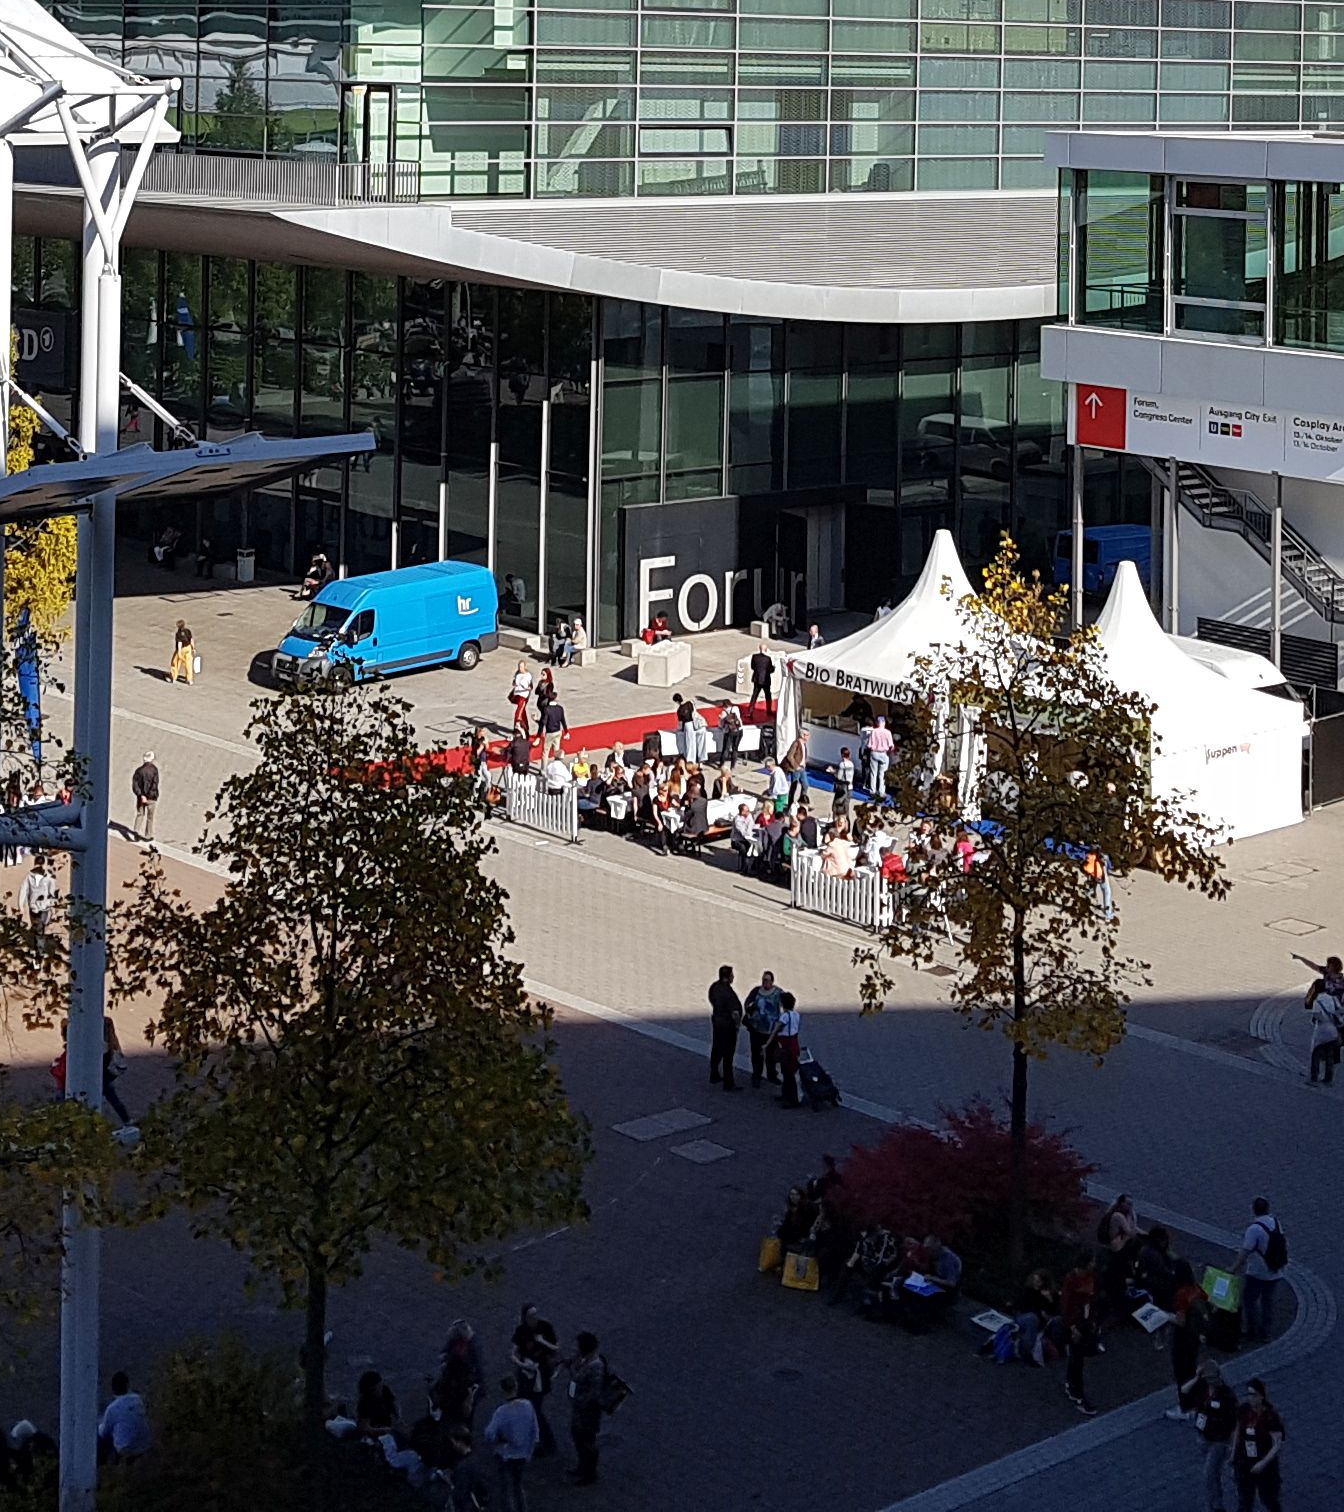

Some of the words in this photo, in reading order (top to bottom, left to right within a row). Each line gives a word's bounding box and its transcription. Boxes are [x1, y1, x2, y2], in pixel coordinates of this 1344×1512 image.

[1133, 409, 1167, 422] Congress
[1168, 413, 1193, 425] Center
[1209, 406, 1242, 420] Ausgang
[1244, 411, 1260, 423] City
[1262, 413, 1277, 423] Exit
[1293, 417, 1331, 432] Cosplay
[457, 595, 478, 614] hr
[806, 663, 830, 683] BIO
